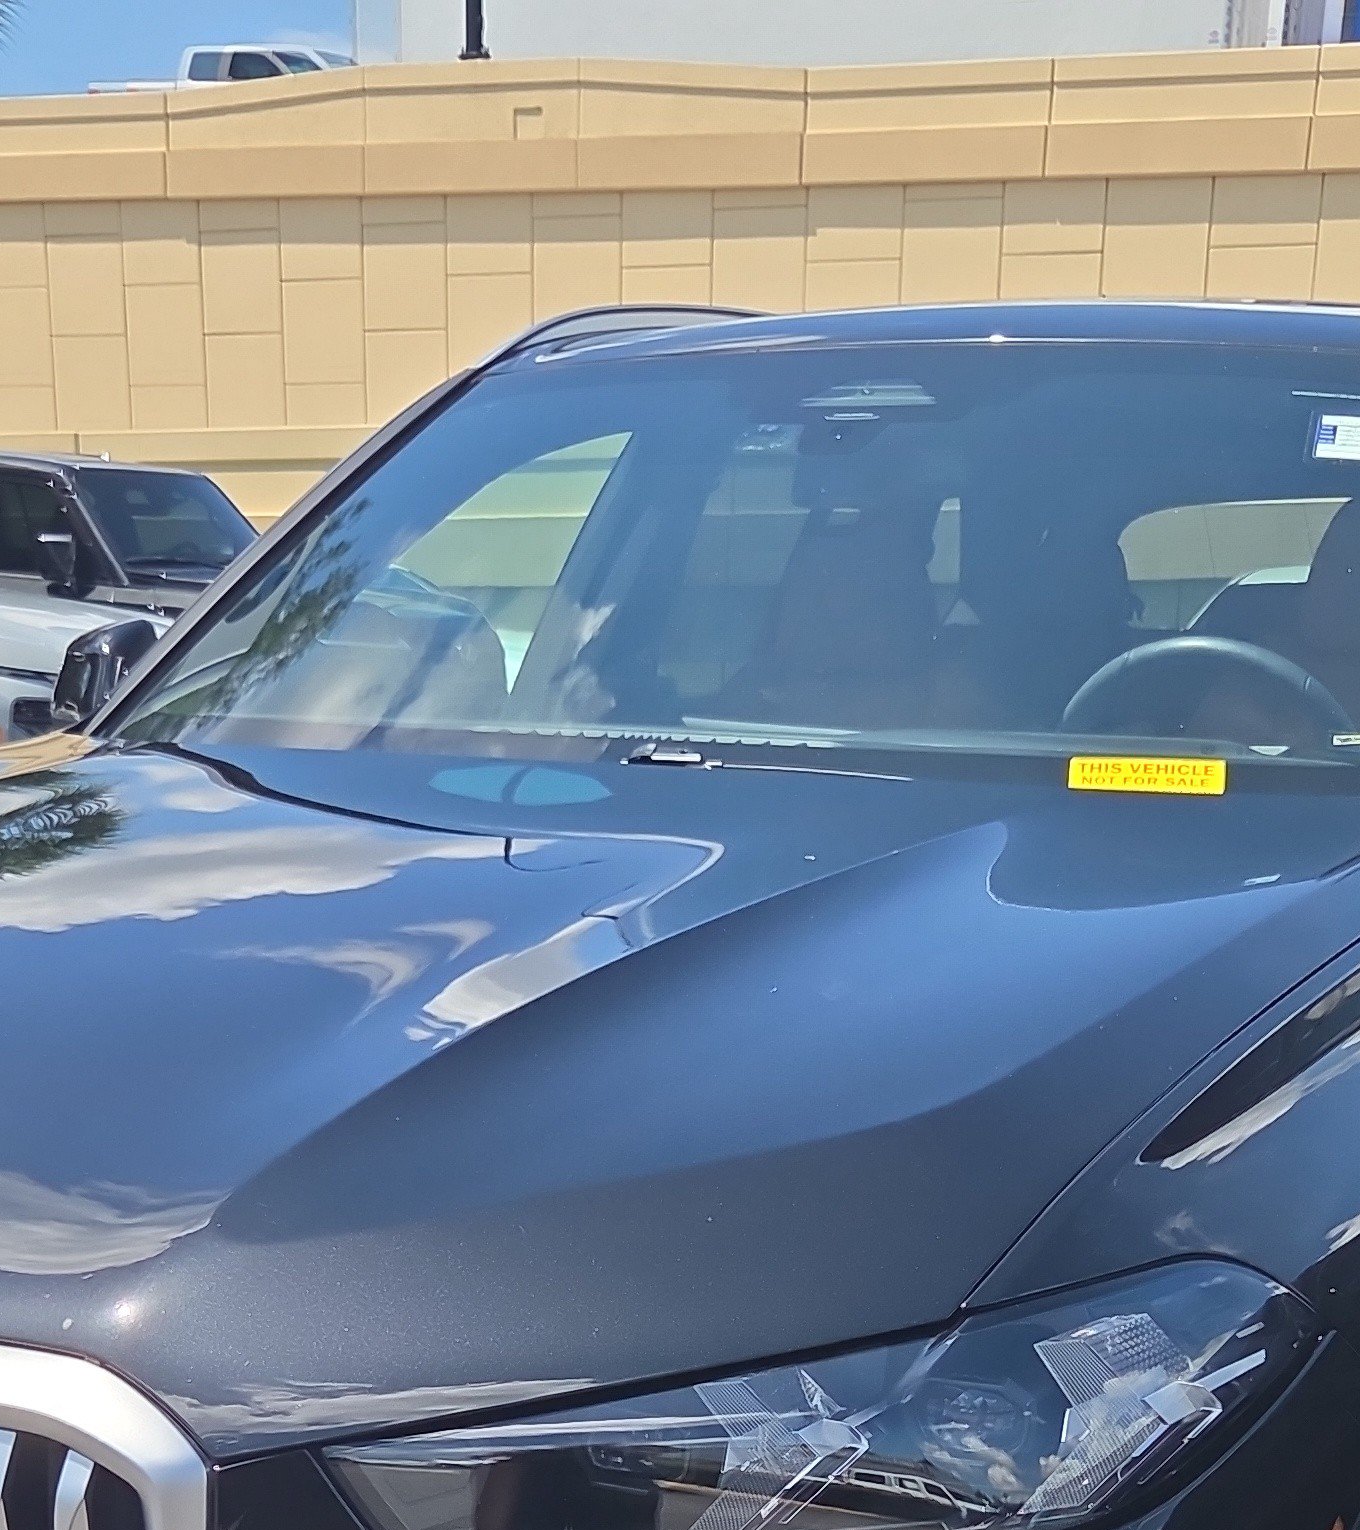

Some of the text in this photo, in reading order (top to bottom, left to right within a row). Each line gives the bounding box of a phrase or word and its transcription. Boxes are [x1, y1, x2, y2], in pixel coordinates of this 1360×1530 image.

[1079, 762, 1215, 777] THIS VEHICLE
[1081, 776, 1210, 788] NOT FOR SALE
